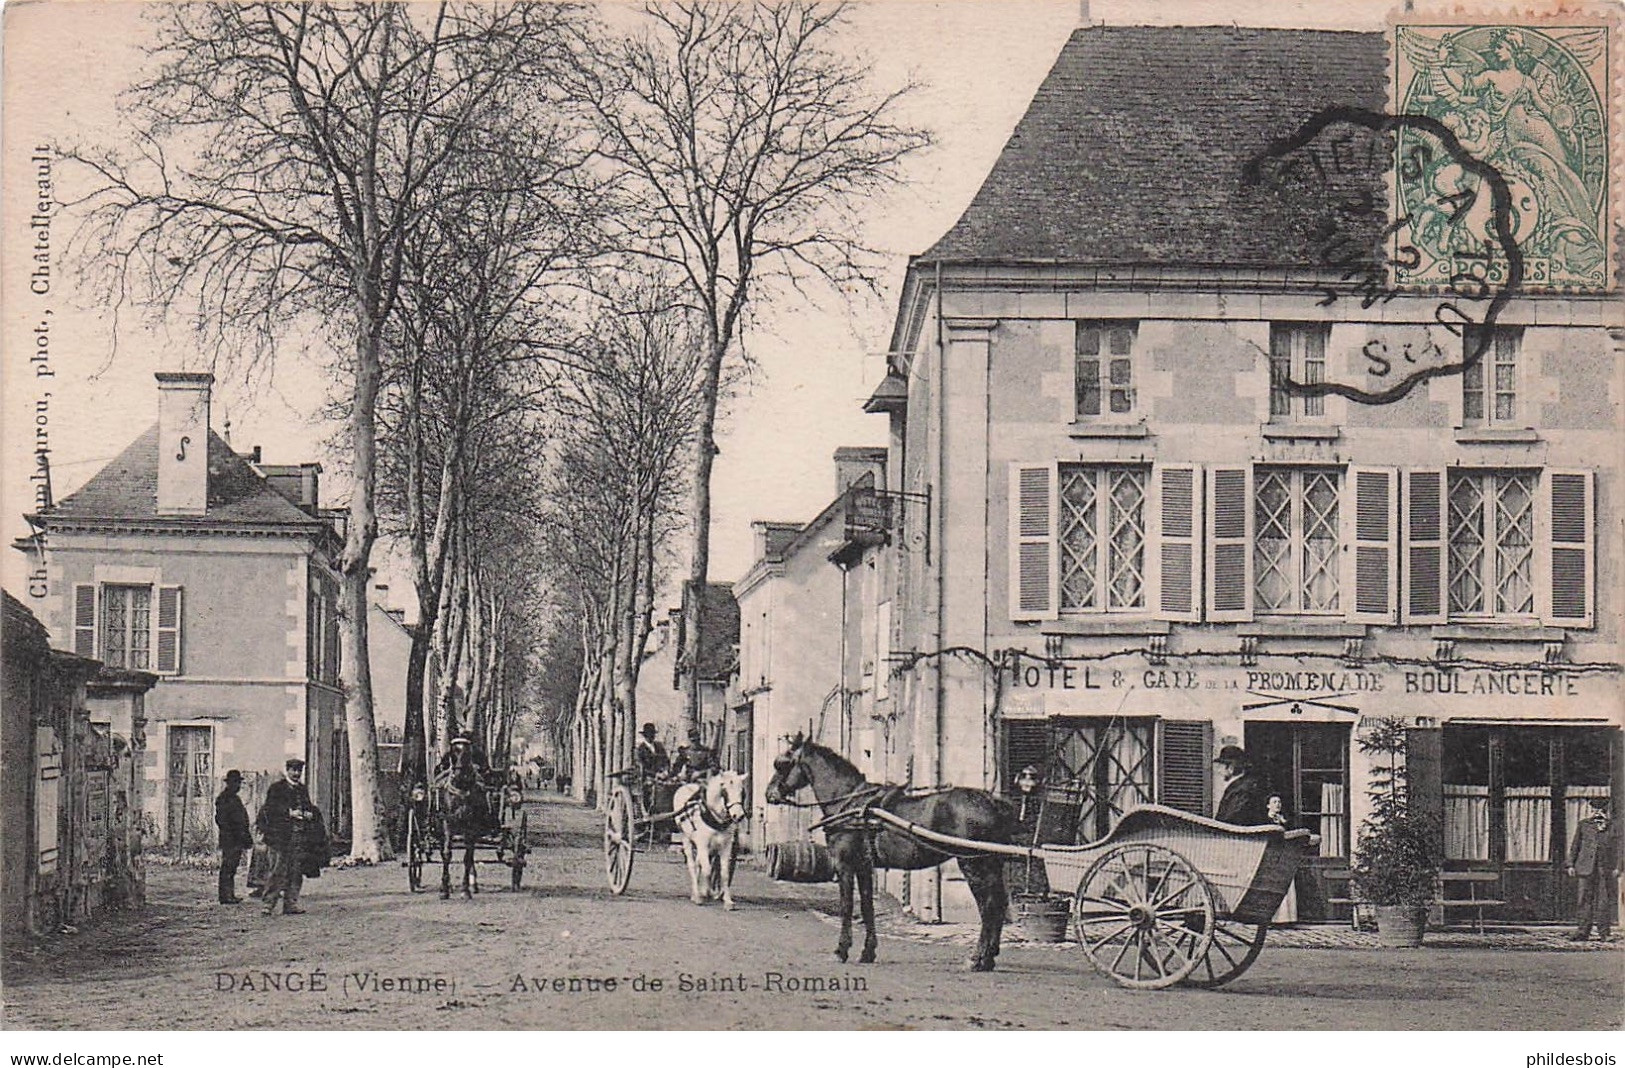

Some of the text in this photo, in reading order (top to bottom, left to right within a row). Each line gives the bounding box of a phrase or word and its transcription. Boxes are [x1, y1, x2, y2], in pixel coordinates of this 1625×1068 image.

[1453, 260, 1548, 282] POSES
[1246, 671, 1384, 692] PROMENADE
[1405, 671, 1579, 696] BOULANGERIE
